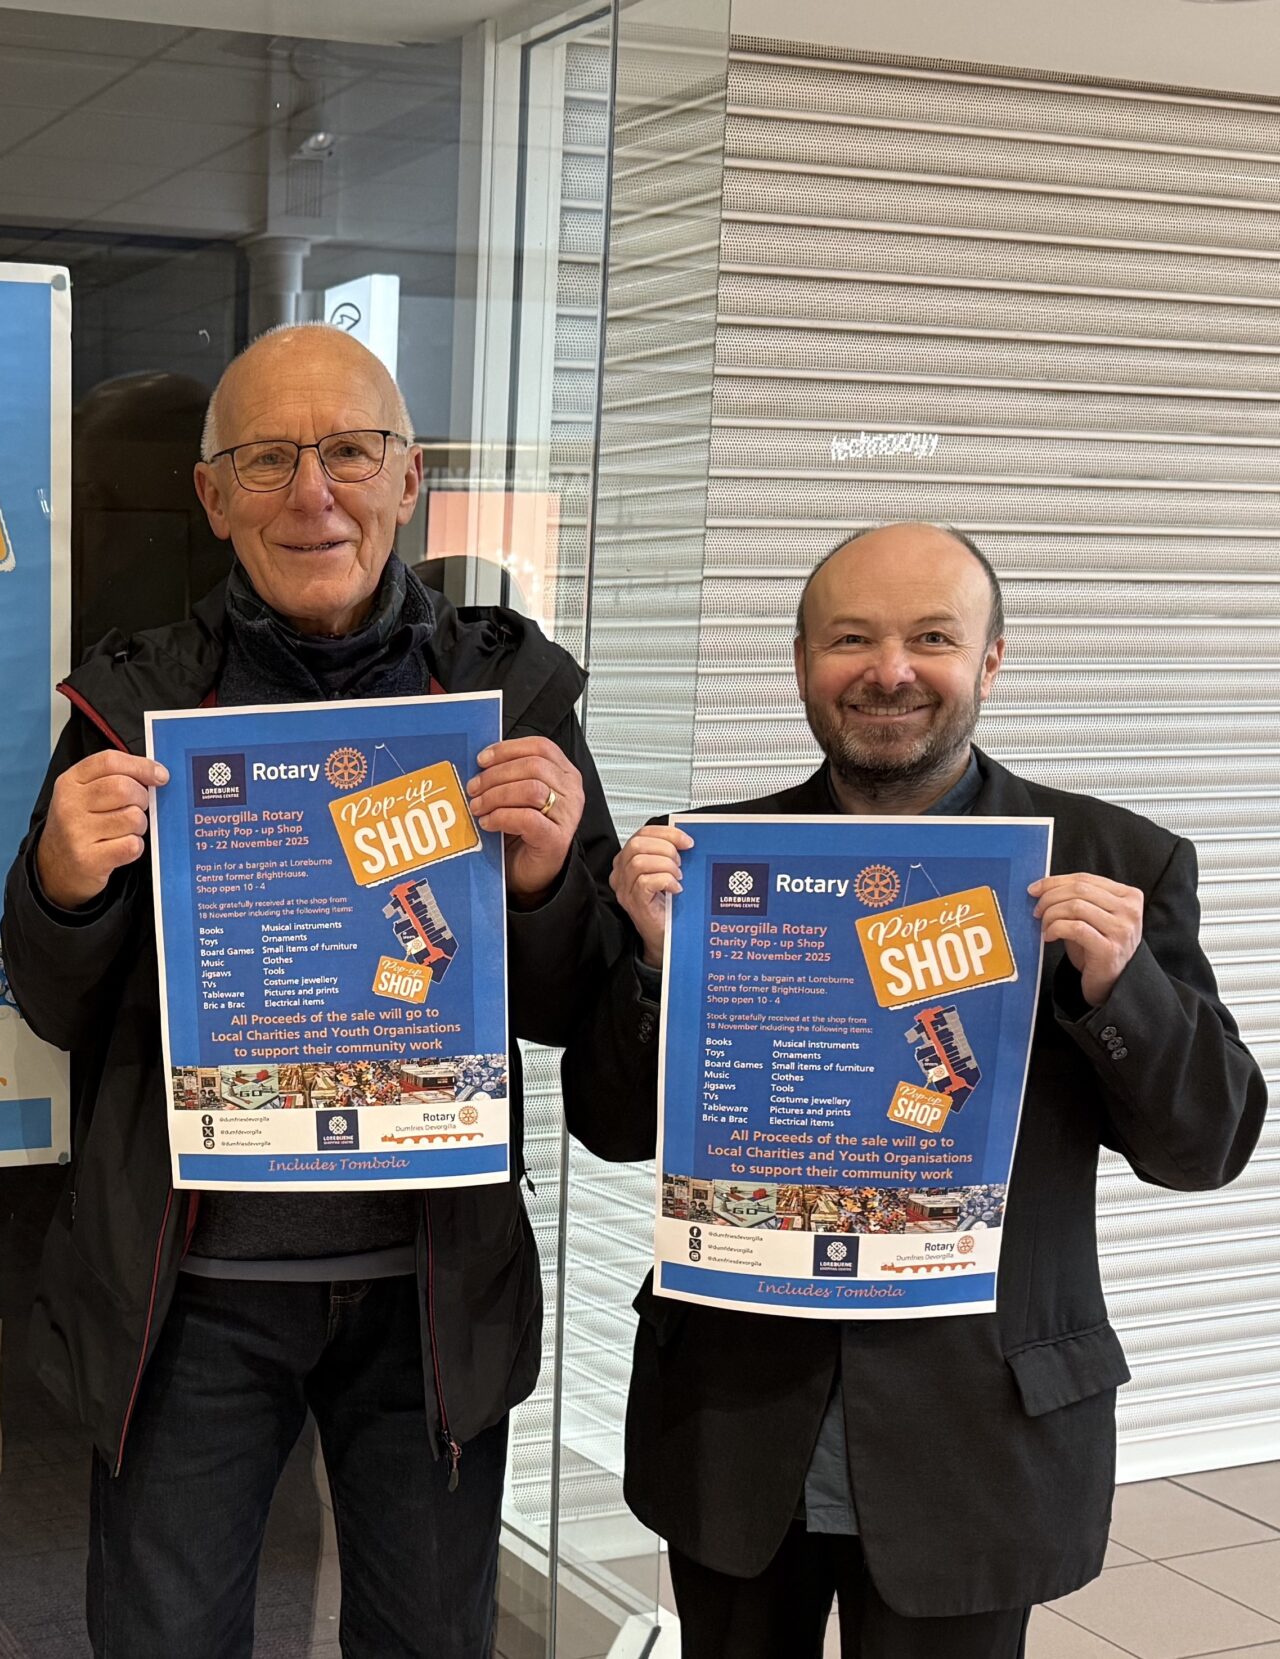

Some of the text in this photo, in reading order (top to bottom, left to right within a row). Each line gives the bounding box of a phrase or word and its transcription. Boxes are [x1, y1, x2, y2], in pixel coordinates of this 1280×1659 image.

[253, 762, 320, 782] Rotary
[340, 778, 448, 827] Pop-up
[194, 810, 304, 826] Devorgilla Rotary
[353, 799, 457, 875] SHOP
[776, 874, 850, 897] Rotary
[261, 922, 342, 931] Musical instruments
[710, 921, 828, 938] Devorgilla Rotary
[867, 903, 985, 947] Pop-up
[262, 934, 308, 943] Ornaments
[262, 945, 284, 954] Small
[310, 943, 319, 951] of
[263, 956, 293, 965] Clothes
[879, 925, 993, 997] SHOP
[263, 966, 285, 975] Tools
[708, 973, 725, 982] Pop
[738, 973, 751, 981] for
[761, 974, 794, 984] bargain
[809, 976, 854, 984] Loreburne
[301, 976, 338, 986] jewellery
[378, 971, 424, 998] SHOP
[298, 987, 313, 995] and
[316, 987, 339, 996] prints
[264, 999, 300, 1007] Electrical
[423, 1112, 456, 1123] Rotary
[893, 1097, 942, 1127] SHOP
[730, 1129, 955, 1150] All Proceeds of the sale will go to
[708, 1144, 973, 1166] Local Charities and Youth Organisations
[268, 1156, 410, 1171] Includes Tombola
[924, 1242, 955, 1253] Rotary
[757, 1281, 906, 1298] Includes Tombola
